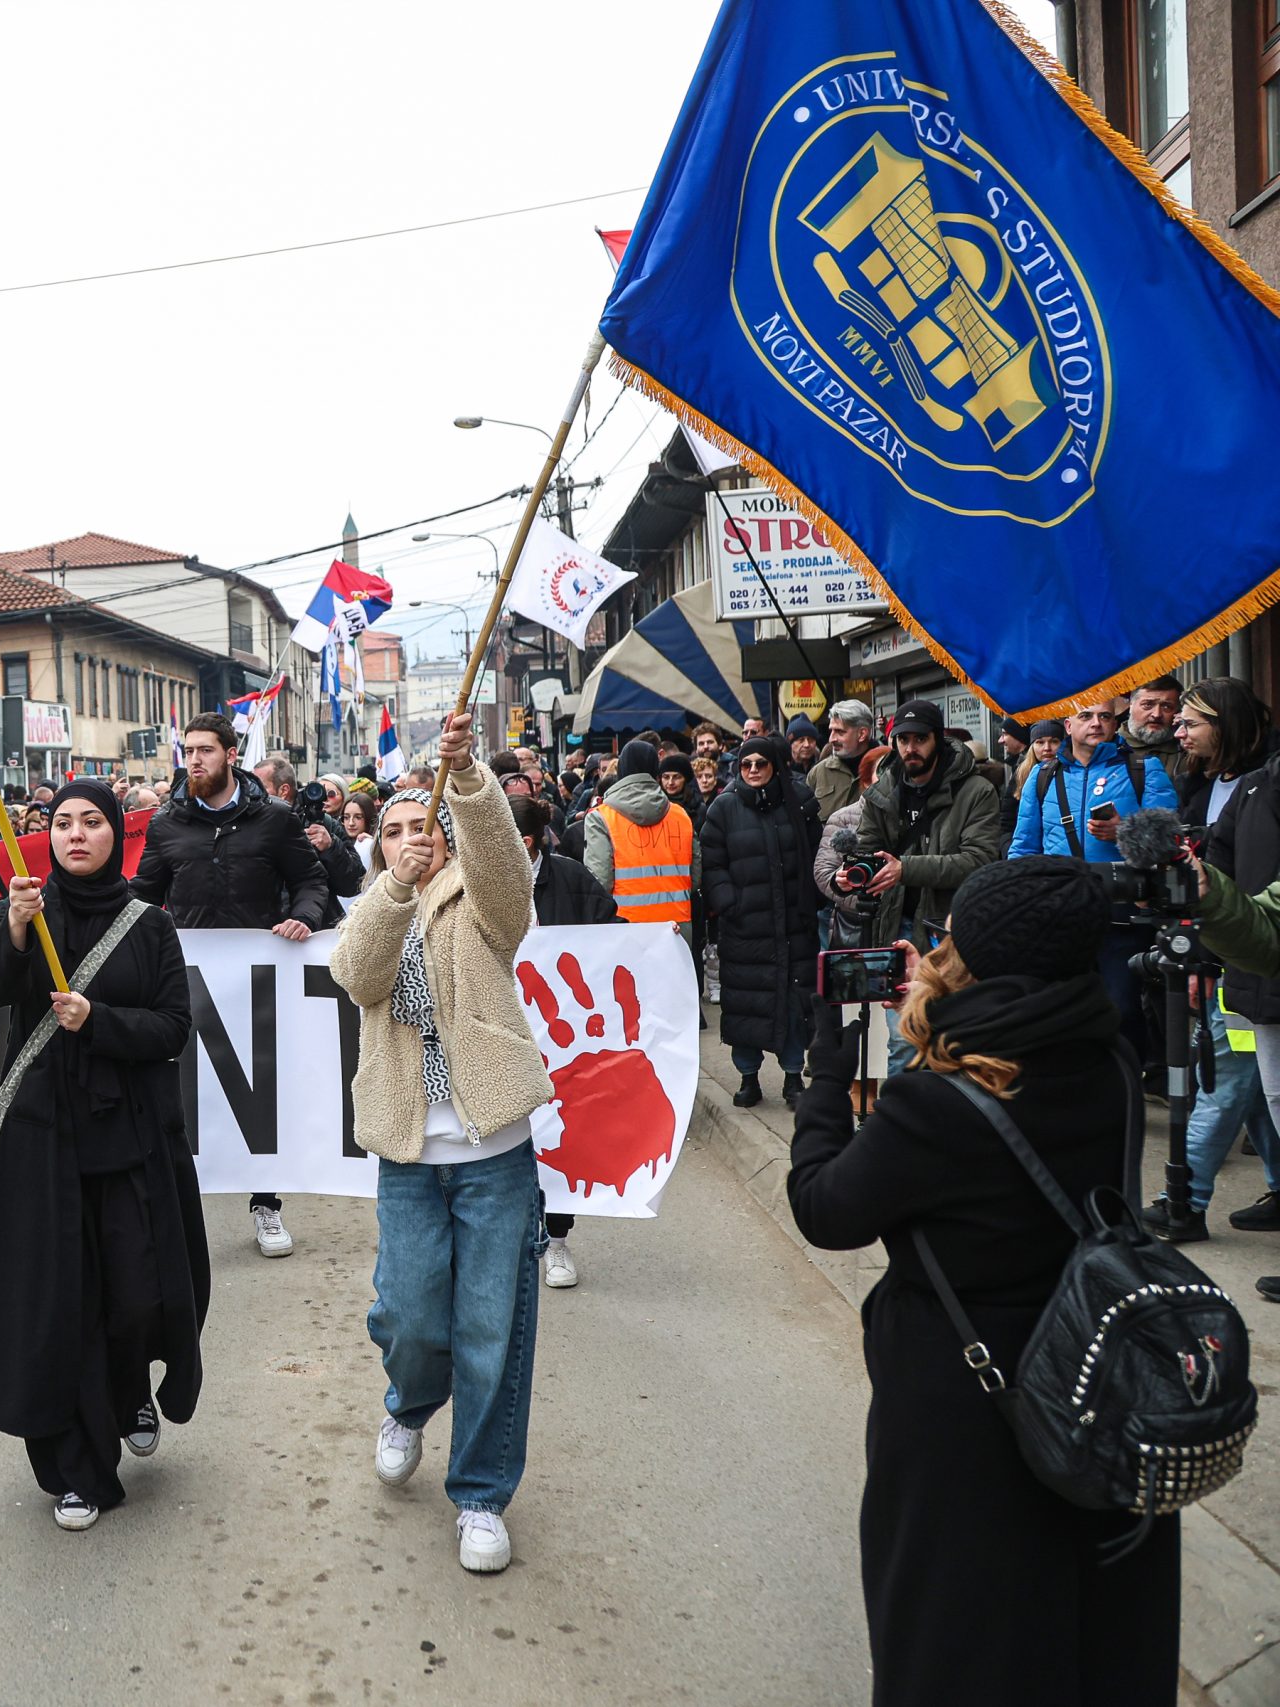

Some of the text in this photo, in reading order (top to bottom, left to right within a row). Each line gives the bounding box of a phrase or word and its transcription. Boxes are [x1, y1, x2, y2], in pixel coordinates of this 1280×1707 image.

[812, 68, 1009, 219] UNIVRSIS
[835, 325, 895, 388] MMVI
[754, 311, 910, 471] NOVI PAZAR
[733, 560, 772, 573] SERIS
[783, 555, 833, 568] PRODAJA
[730, 590, 749, 598] 020
[760, 587, 777, 596] 31
[788, 585, 808, 594] 444
[825, 583, 844, 591] 020
[855, 581, 871, 589] 33
[730, 601, 749, 610] 063
[760, 599, 778, 608] 31
[789, 596, 809, 605] 444
[826, 594, 845, 603] 062
